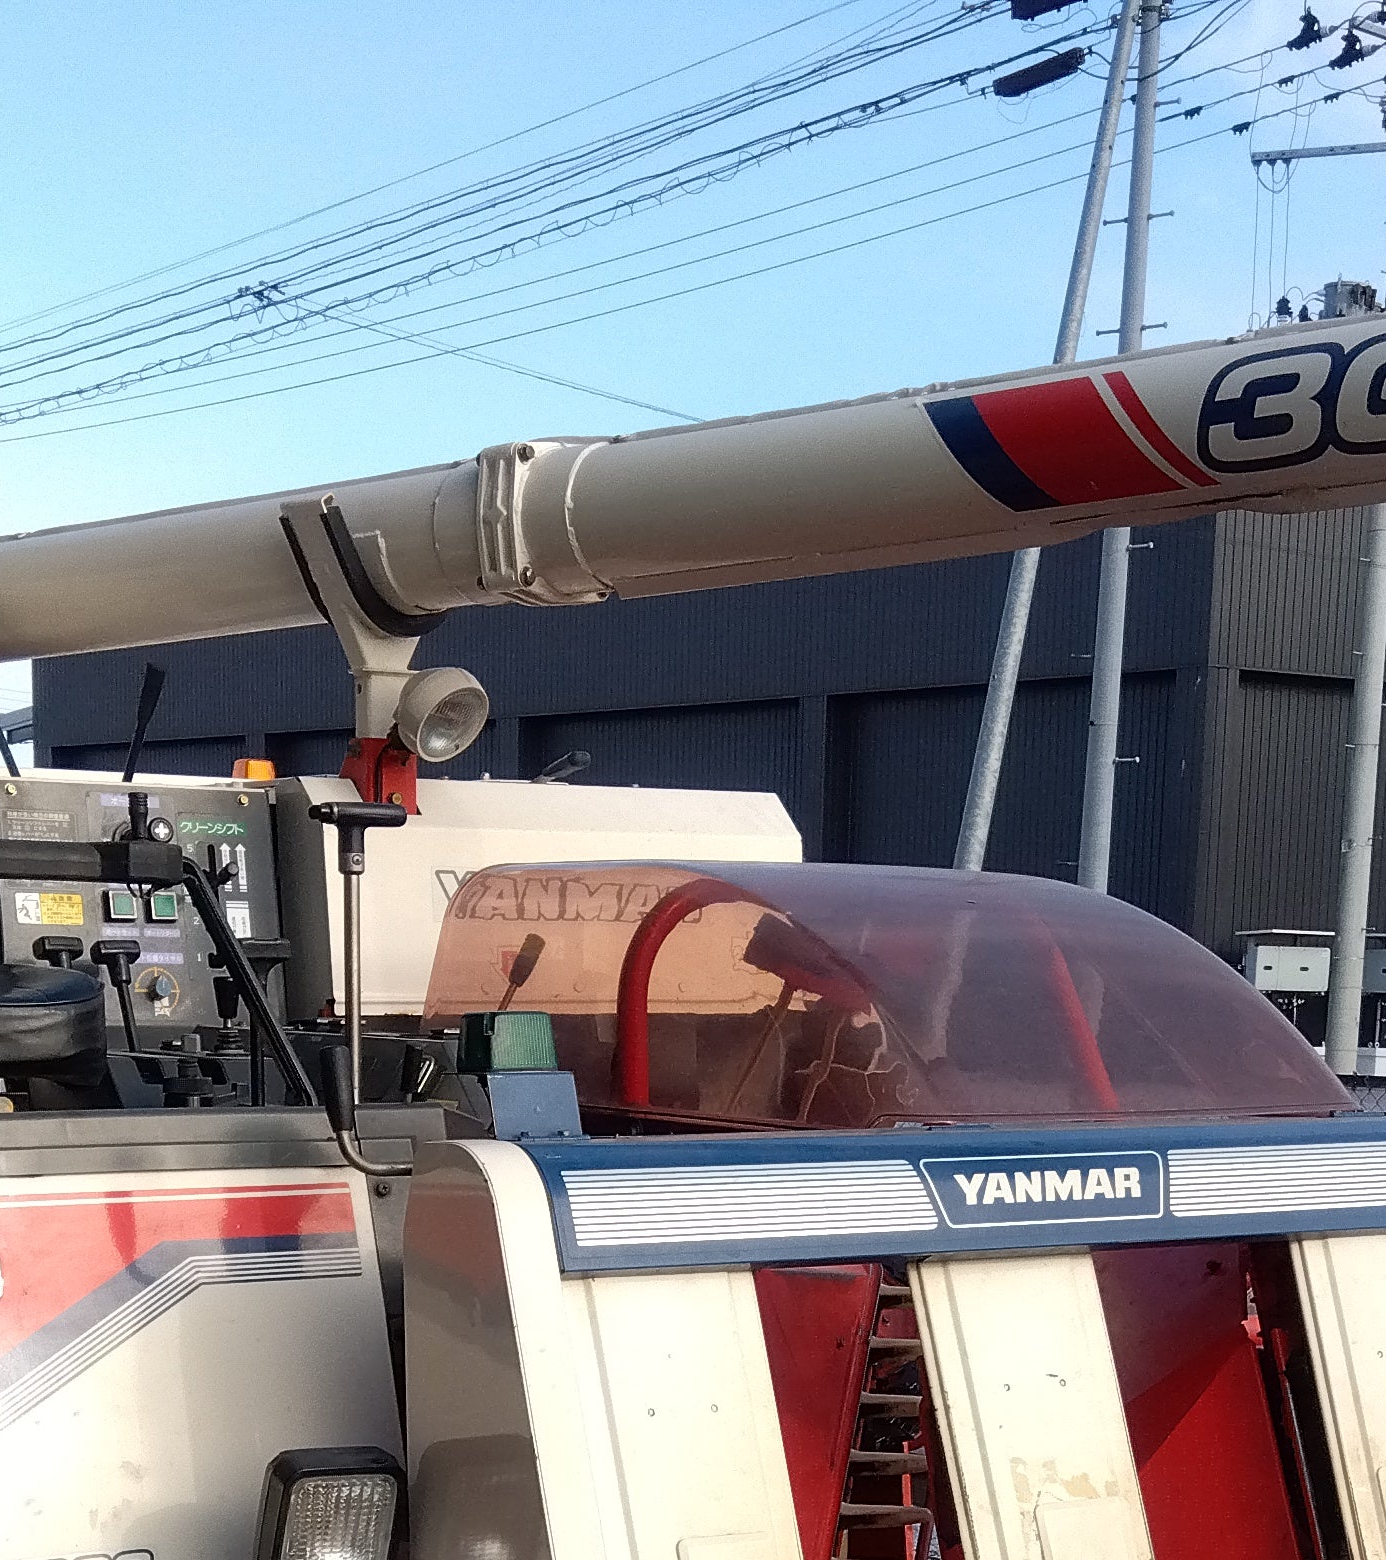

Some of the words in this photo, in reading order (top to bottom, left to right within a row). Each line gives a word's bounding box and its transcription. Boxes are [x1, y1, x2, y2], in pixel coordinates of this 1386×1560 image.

[179, 821, 244, 835] クリーンシフト
[434, 869, 704, 924] YANMA
[193, 916, 201, 925] 2
[953, 1167, 1142, 1206] YANMAR
